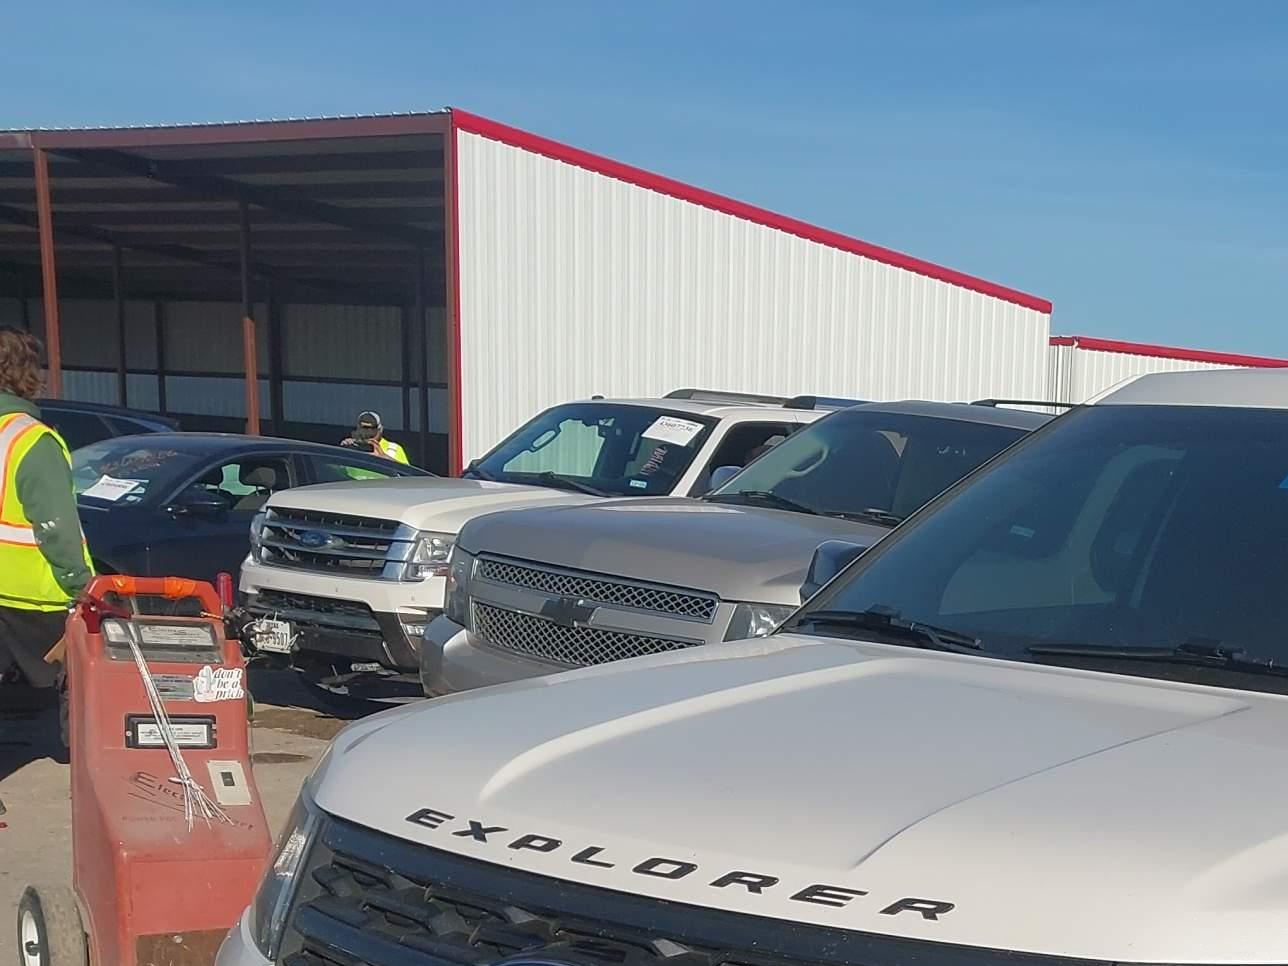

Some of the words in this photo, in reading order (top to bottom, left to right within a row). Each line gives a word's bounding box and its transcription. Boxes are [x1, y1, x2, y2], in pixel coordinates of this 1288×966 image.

[213, 668, 242, 679] don't
[216, 678, 229, 688] be
[404, 807, 956, 922] EXPLORER
